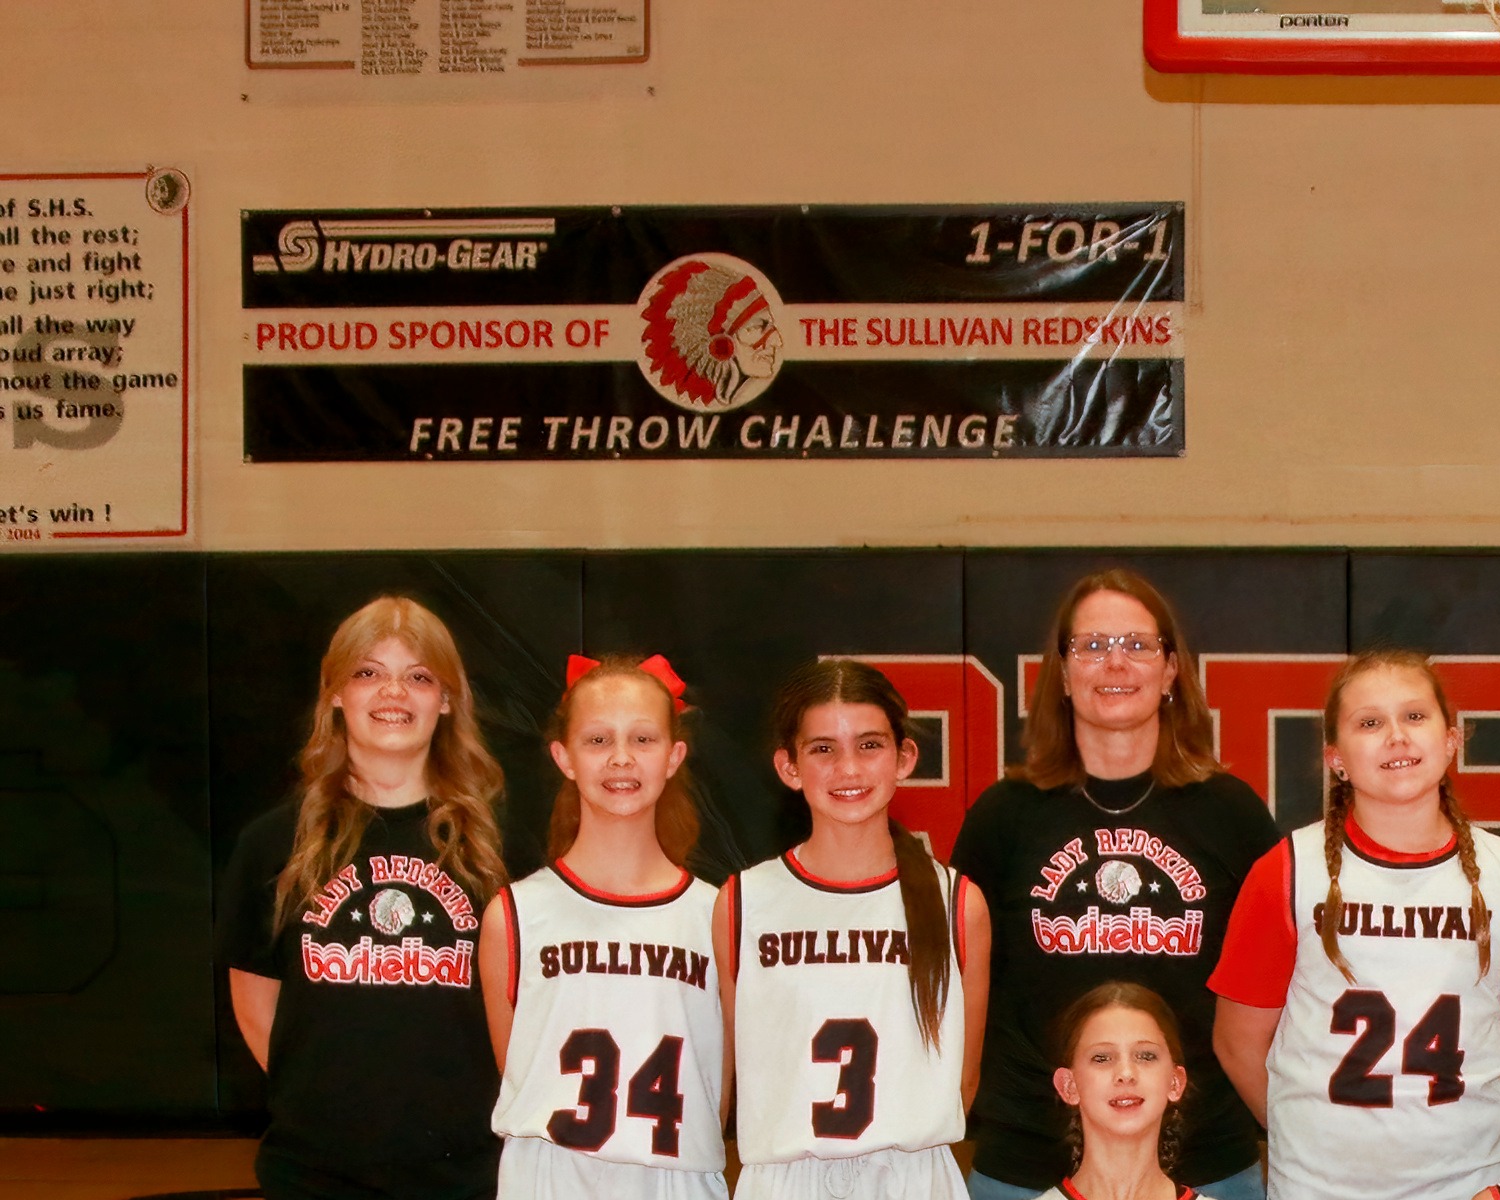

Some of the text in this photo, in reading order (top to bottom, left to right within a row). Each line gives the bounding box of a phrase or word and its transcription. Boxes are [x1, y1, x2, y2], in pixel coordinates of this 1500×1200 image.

[28, 198, 94, 217] S.H.S.
[31, 225, 71, 245] the
[83, 225, 139, 246] rest;
[965, 213, 1173, 265] 1-FOR-1
[28, 252, 71, 273] and
[83, 251, 142, 276] fight
[29, 280, 76, 305] just
[87, 278, 154, 303] right;
[34, 314, 75, 334] the
[86, 318, 136, 337] way
[256, 318, 610, 351] PROUD SPONSOR OF
[800, 315, 1173, 347] THE SULLIVAN REDSKINS
[52, 346, 123, 367] array;
[63, 371, 101, 391] the
[112, 372, 178, 394] game
[17, 403, 44, 420] us
[56, 399, 124, 419] fame.
[409, 412, 1021, 454] FREE THROW CHALLENGE
[49, 502, 94, 523] win
[1030, 828, 1207, 903] LADY REDSKINS
[302, 855, 479, 932] LADY REDSKINS
[758, 929, 909, 968] SULLIVA
[1032, 906, 1204, 956] basketball
[302, 933, 474, 989] basketball
[540, 940, 710, 991] SULLIVAN
[1329, 988, 1466, 1109] 24
[546, 1028, 685, 1159] 34
[811, 1017, 879, 1140] 3
